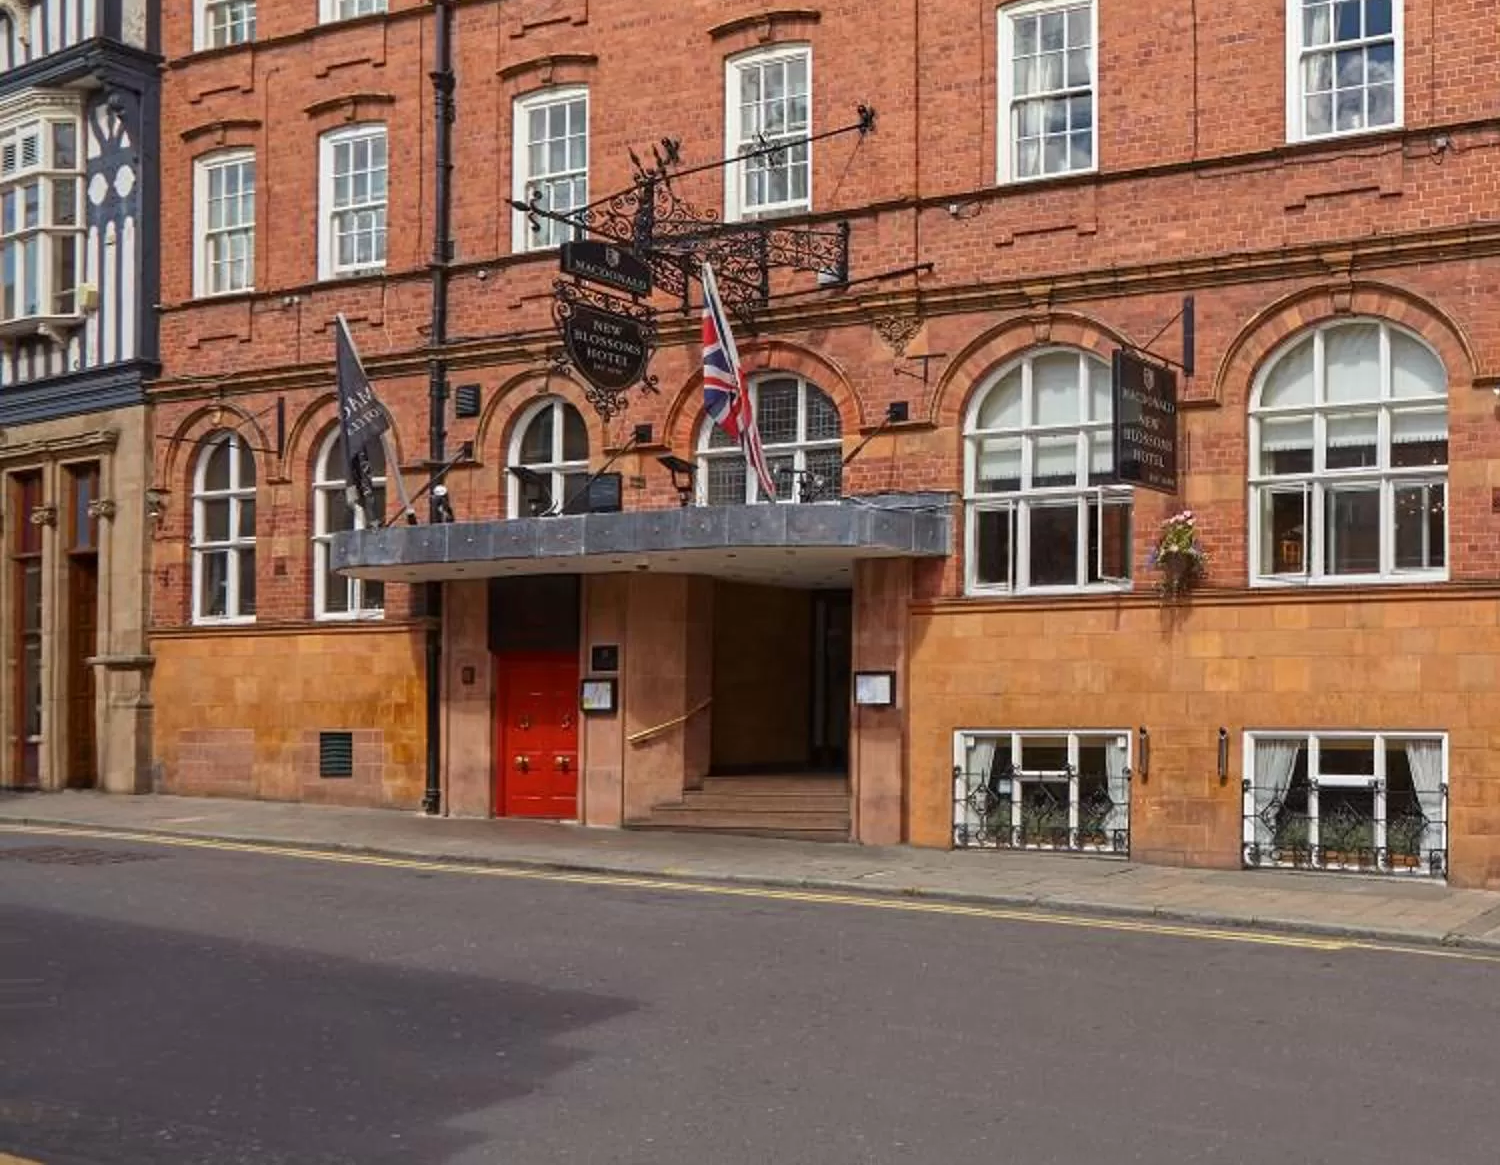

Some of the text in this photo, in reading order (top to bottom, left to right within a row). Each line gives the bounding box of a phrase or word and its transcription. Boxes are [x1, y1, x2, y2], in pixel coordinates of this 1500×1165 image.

[593, 319, 622, 336] NEW
[574, 329, 641, 355] BLOSSOMS
[587, 346, 628, 367] HOTEL
[1133, 448, 1165, 468] HOTEL
